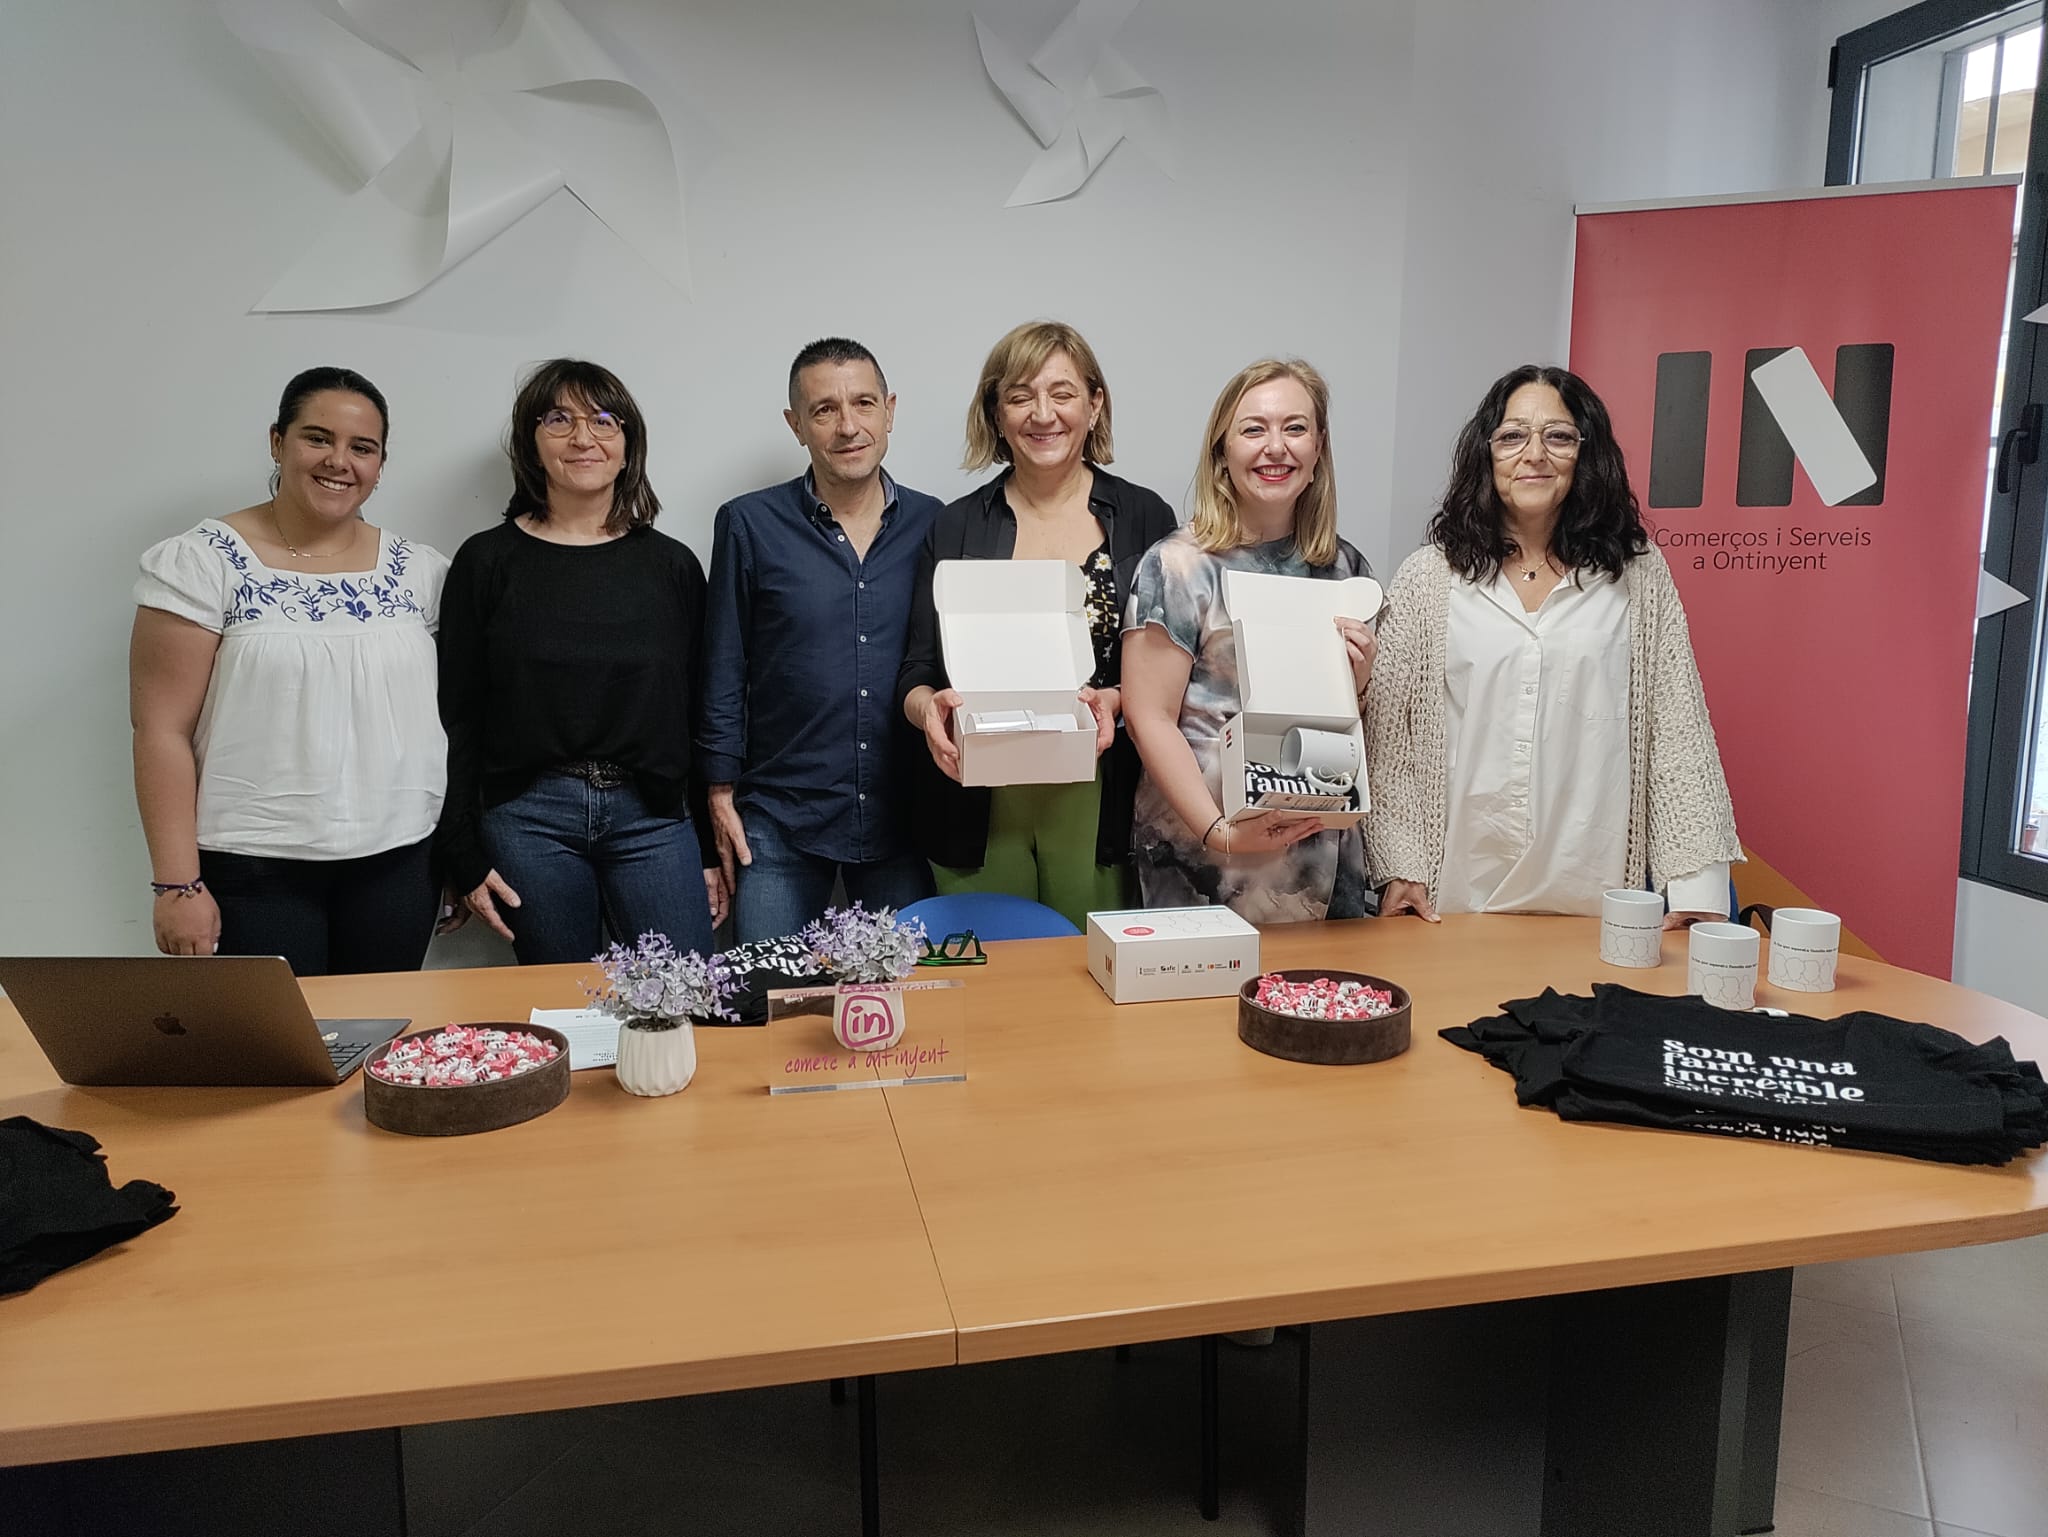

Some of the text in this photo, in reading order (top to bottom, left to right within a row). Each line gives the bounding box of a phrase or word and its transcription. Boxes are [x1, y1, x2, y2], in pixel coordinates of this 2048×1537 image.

[1648, 343, 1895, 508] IN
[1654, 527, 1872, 550] Comerços i Serveis
[1693, 551, 1828, 575] a Ontinyent
[850, 1005, 886, 1036] in
[848, 1055, 857, 1069] a
[865, 1038, 949, 1078] ontinyent
[1768, 1056, 1858, 1076] una
